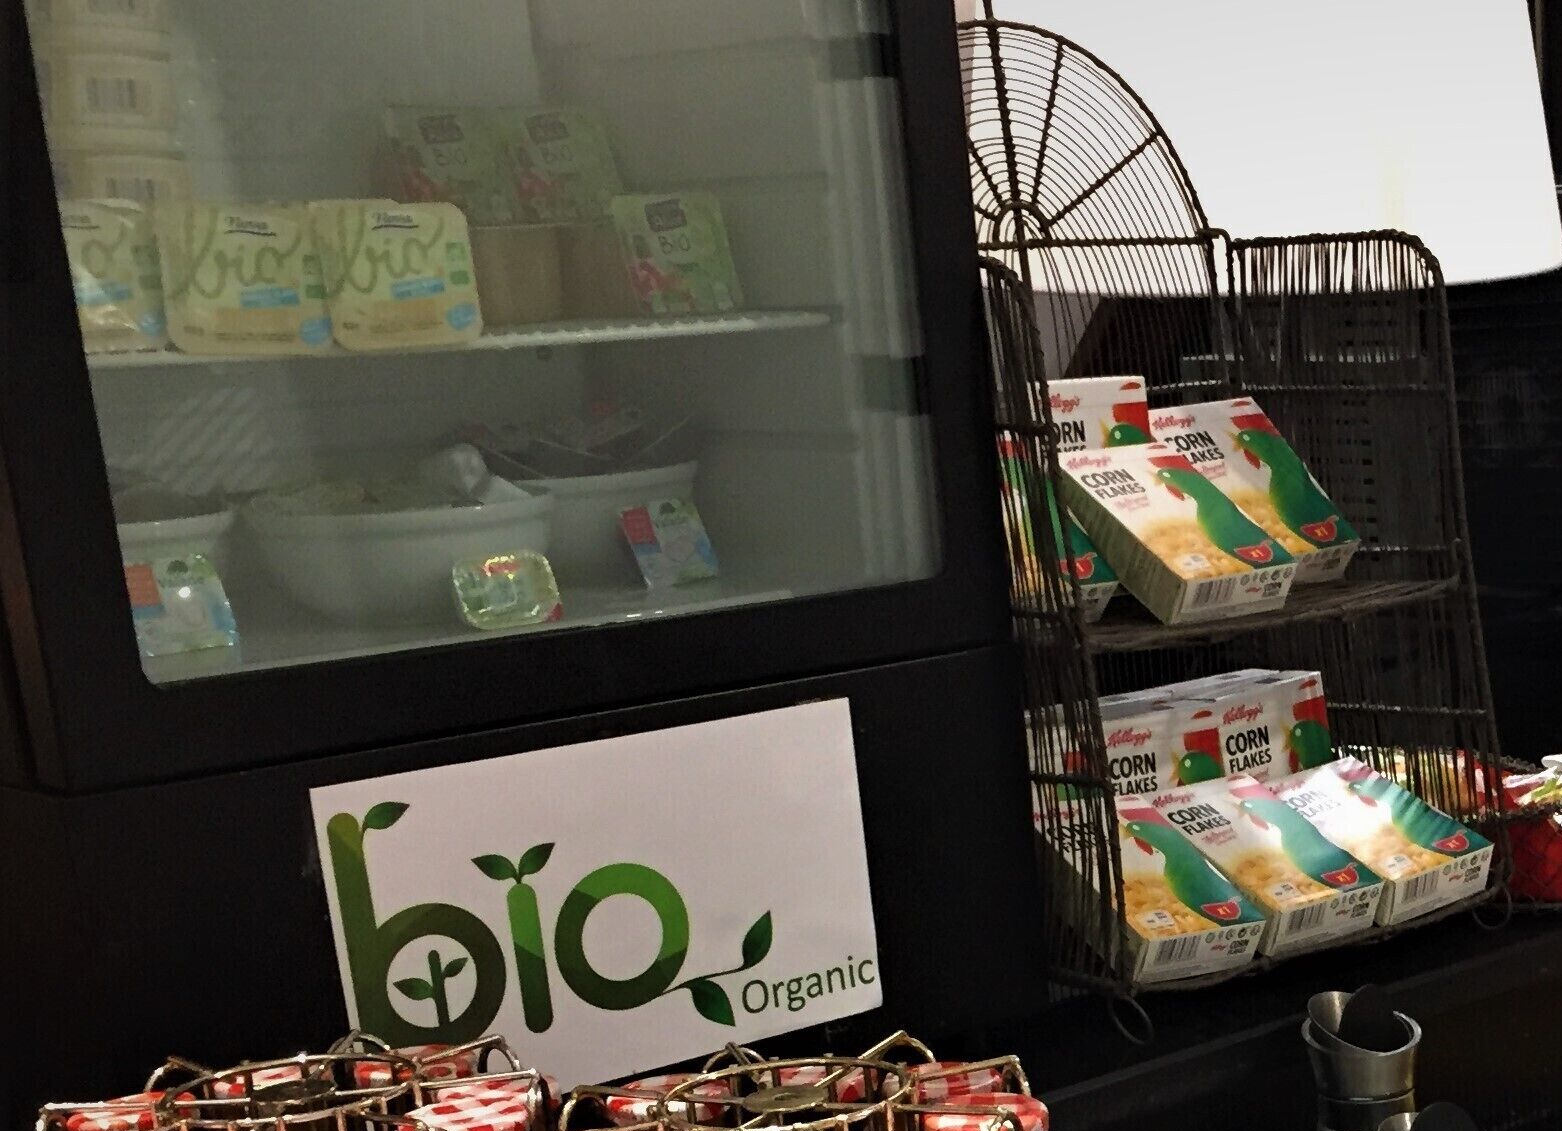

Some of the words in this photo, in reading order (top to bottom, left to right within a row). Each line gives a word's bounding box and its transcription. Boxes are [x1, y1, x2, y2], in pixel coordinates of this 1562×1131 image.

[1050, 393, 1081, 414] ellogg's
[1053, 420, 1087, 445] ORN
[1080, 468, 1136, 489] CORN
[1094, 482, 1147, 500] FLAKES
[1222, 702, 1264, 725] Kellogg's
[1107, 727, 1152, 748] Kellogg's
[1225, 725, 1270, 756] CORN
[1109, 751, 1157, 780] CORN
[1229, 748, 1272, 774] FLAKES
[1112, 776, 1158, 796] FLAKES
[1167, 801, 1221, 823] CORN
[1181, 815, 1232, 836] FLAKES
[327, 812, 690, 1049] bio
[741, 955, 876, 1014] Organic
